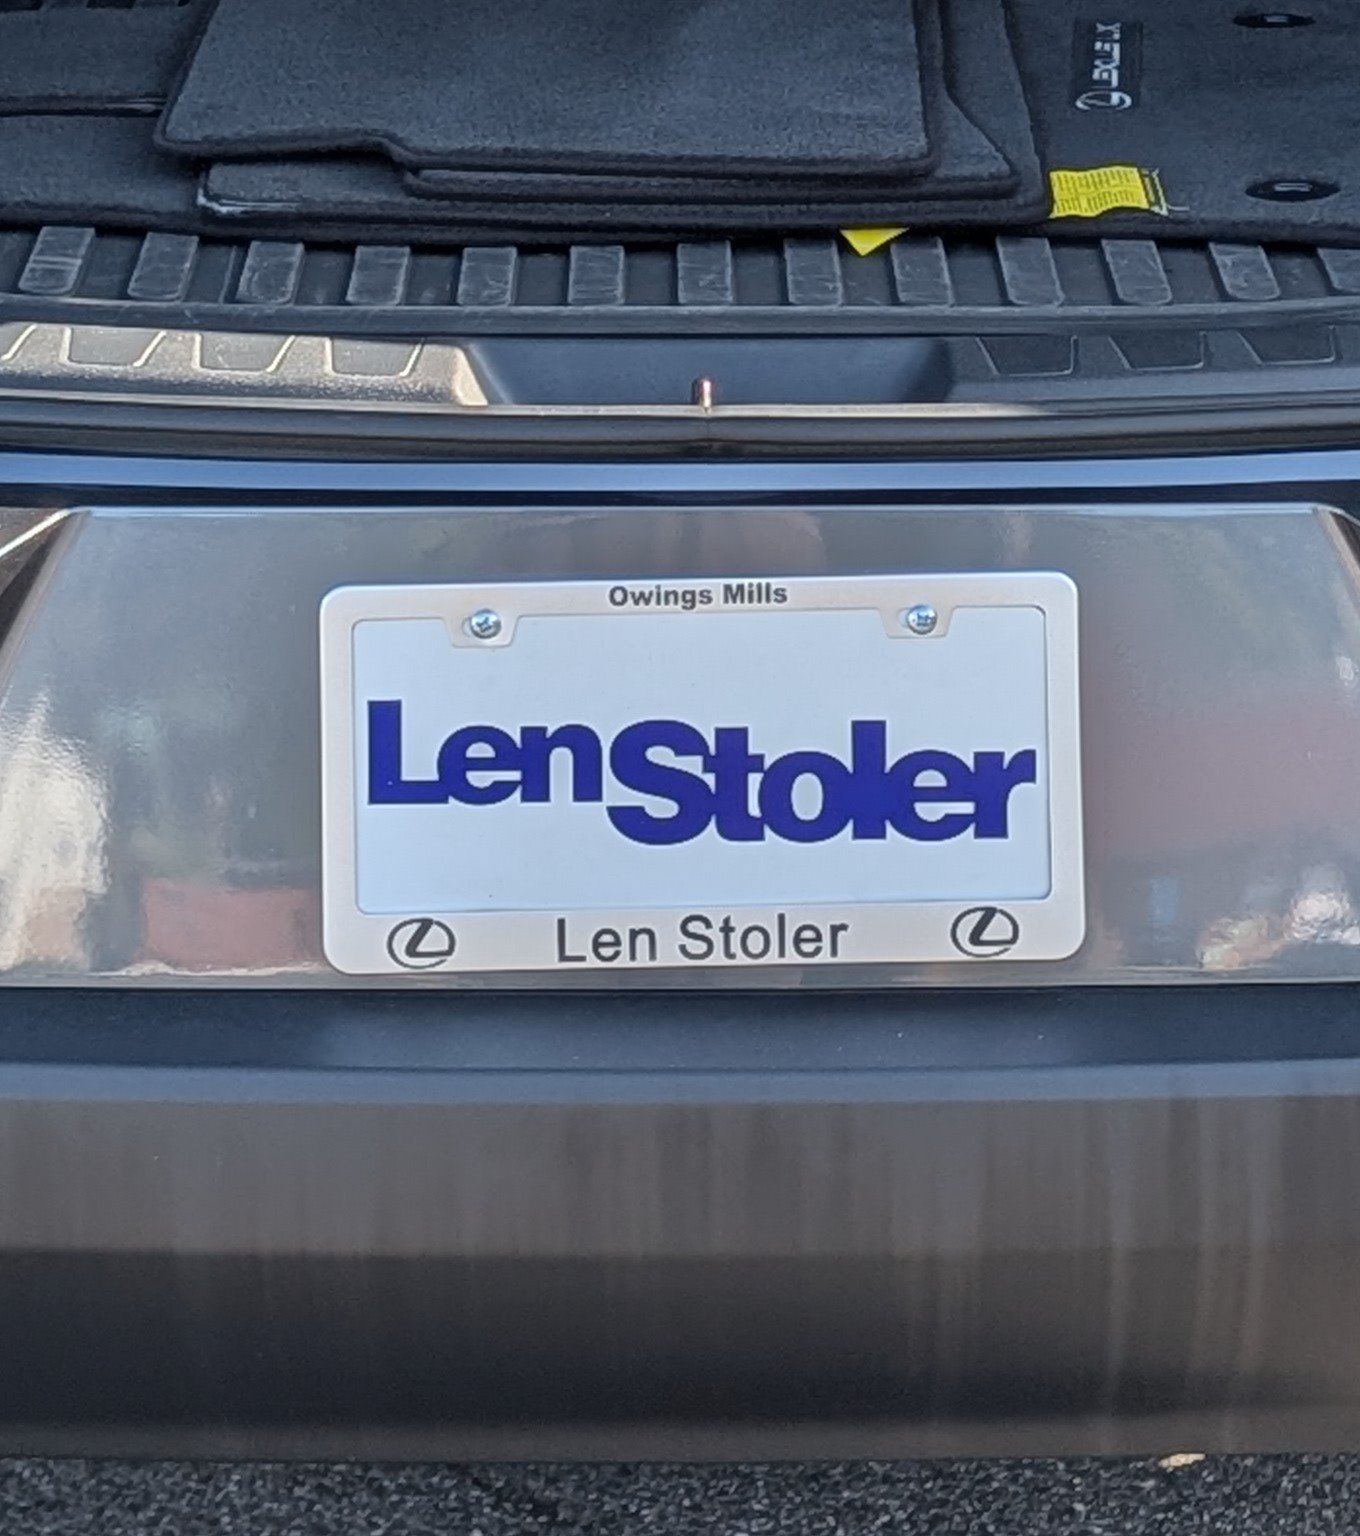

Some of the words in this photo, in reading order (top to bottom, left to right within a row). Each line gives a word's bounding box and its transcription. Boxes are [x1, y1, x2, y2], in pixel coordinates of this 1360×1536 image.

[1092, 22, 1121, 89] LEXUS
[608, 584, 714, 609] Owings
[722, 582, 789, 605] Mills
[555, 917, 658, 962] Len
[678, 914, 848, 961] Stoler
